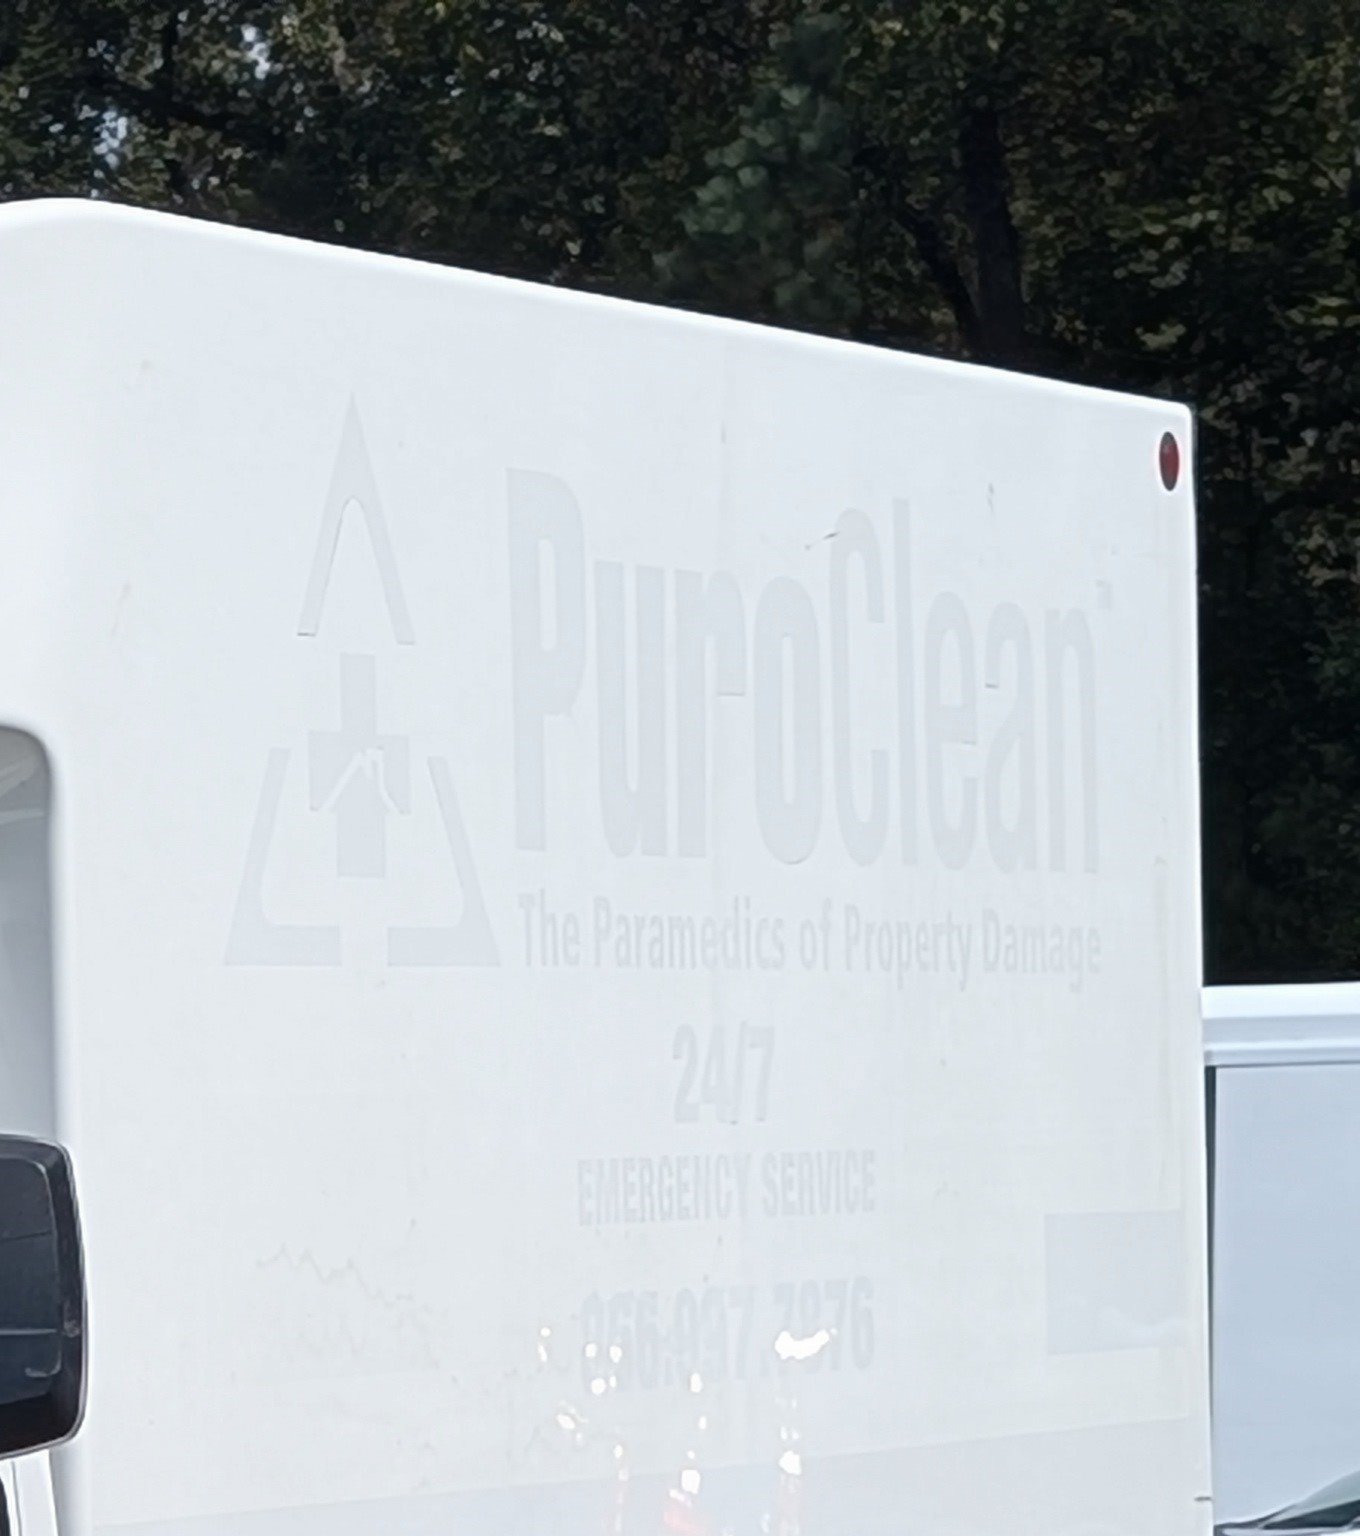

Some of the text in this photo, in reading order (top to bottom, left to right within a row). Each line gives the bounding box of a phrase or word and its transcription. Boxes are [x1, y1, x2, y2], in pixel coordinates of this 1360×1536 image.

[506, 467, 1098, 873] PuroClean
[519, 889, 1102, 993] The Paramedics of Property Damage
[672, 1021, 776, 1124] 24/7
[576, 1149, 876, 1227] EMERGENCY SERVICE
